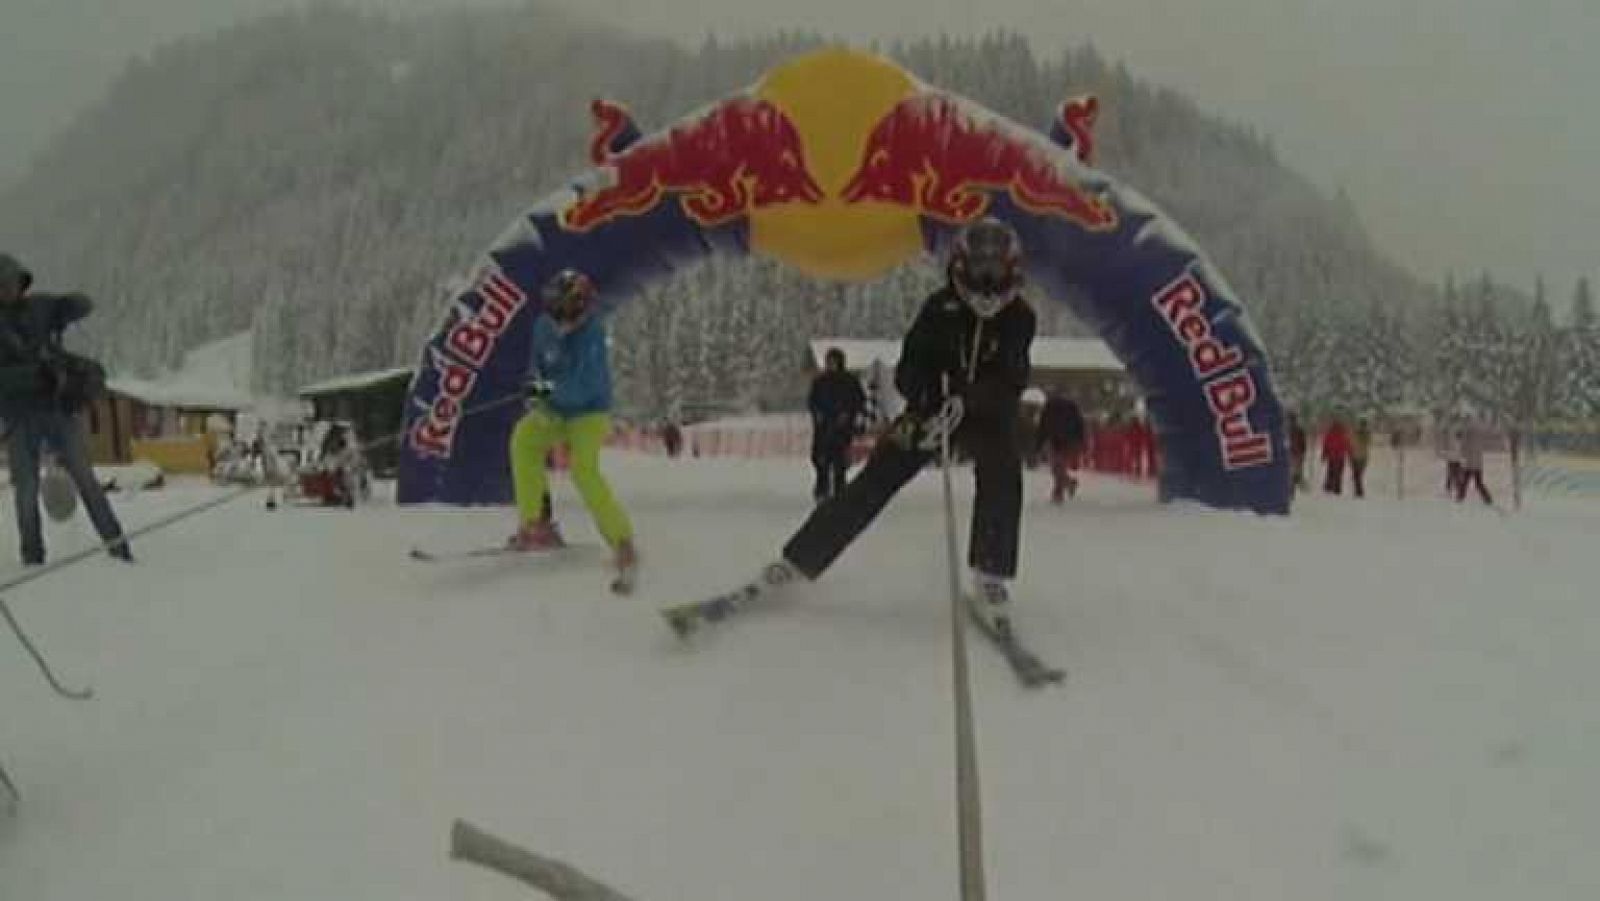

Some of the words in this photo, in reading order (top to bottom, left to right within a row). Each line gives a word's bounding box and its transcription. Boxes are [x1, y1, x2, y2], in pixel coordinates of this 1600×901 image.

[409, 346, 479, 459] Red
[446, 268, 528, 368] Bull
[1152, 272, 1244, 380] Red
[1203, 367, 1274, 470] Bull
